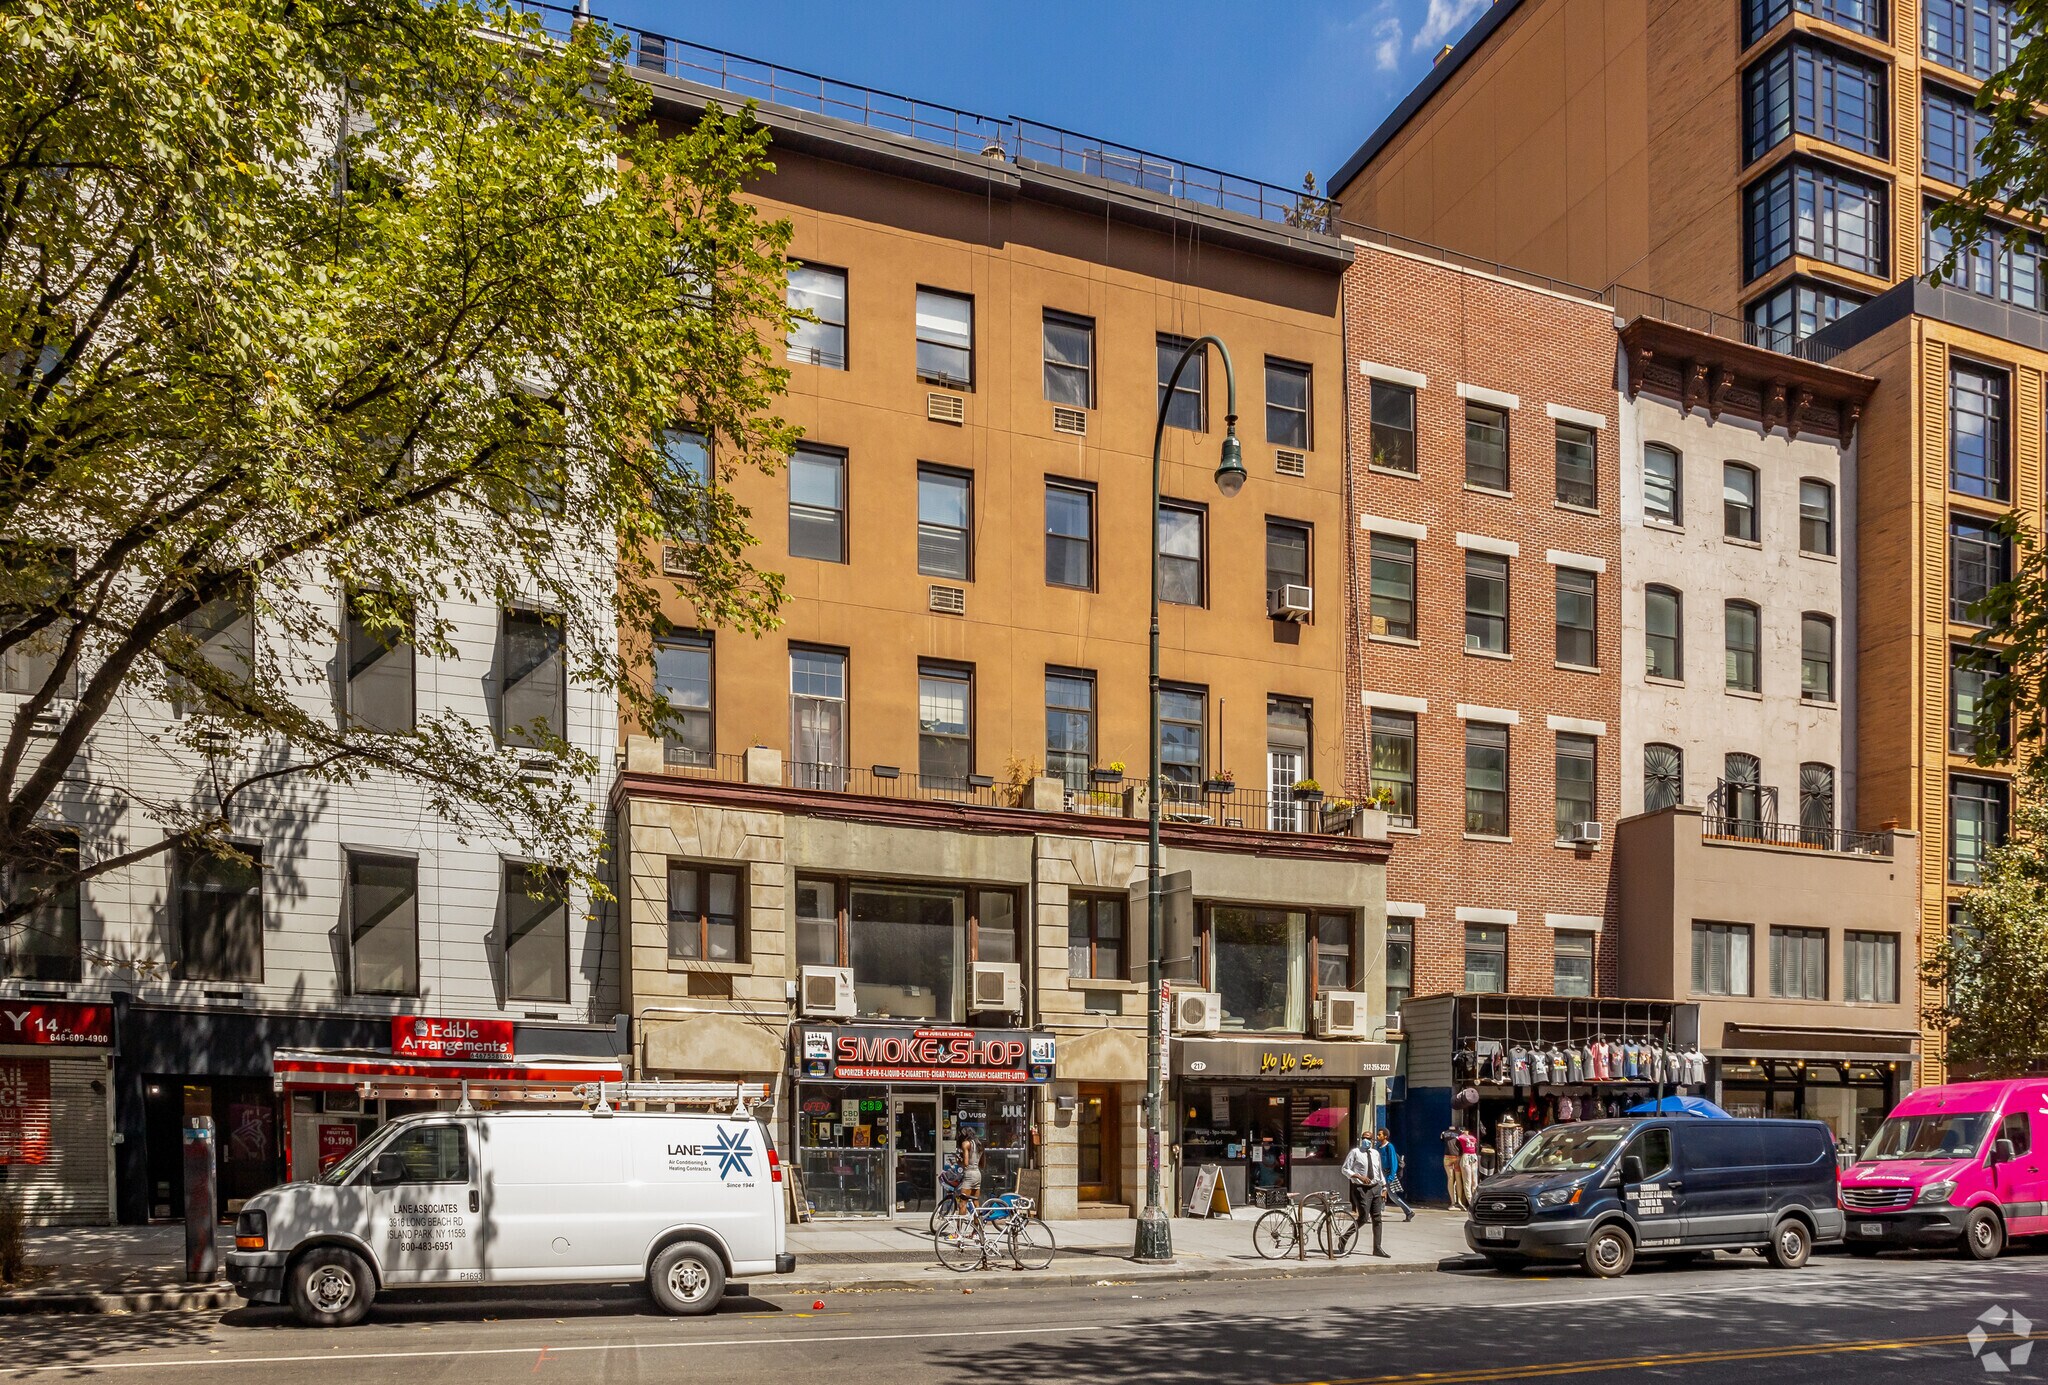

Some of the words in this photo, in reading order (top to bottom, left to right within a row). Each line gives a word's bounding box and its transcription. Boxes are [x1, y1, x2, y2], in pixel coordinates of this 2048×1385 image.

[35, 1017, 59, 1032] 14
[431, 1021, 479, 1038] Edible
[50, 1033, 108, 1043] 646-609-4900
[401, 1036, 508, 1056] Arrangements
[837, 1036, 938, 1063] SMOKE
[951, 1039, 1026, 1065] SHOP
[1193, 1062, 1205, 1070] 217
[1261, 1052, 1278, 1071] Yo
[1280, 1052, 1297, 1071] Yo
[1301, 1053, 1325, 1069] Spa
[838, 1068, 864, 1077] VAPORIZER
[931, 1070, 945, 1078] CIGAR
[947, 1070, 966, 1079] TOBACCO
[967, 1071, 987, 1079] HOOKAH
[987, 1071, 1011, 1080] CIGARETTE
[1012, 1072, 1026, 1080] LOTTO
[803, 1101, 831, 1112] OPEN
[860, 1100, 883, 1111] CBD
[843, 1110, 858, 1118] CBD
[323, 1136, 353, 1145] $9.99
[668, 1144, 702, 1156] LANE
[394, 1205, 413, 1213] LANE
[414, 1204, 458, 1213] ASSOCIATES
[389, 1218, 405, 1227] 3916
[406, 1217, 427, 1227] LONG
[428, 1217, 452, 1227] BEACH
[453, 1216, 464, 1226] RD
[387, 1229, 413, 1239] ISLAND
[414, 1229, 434, 1239] PARK,
[435, 1229, 446, 1238] NY
[447, 1228, 466, 1238] 11558
[400, 1242, 453, 1251] 800-483-6951
[461, 1272, 483, 1281] P1693
